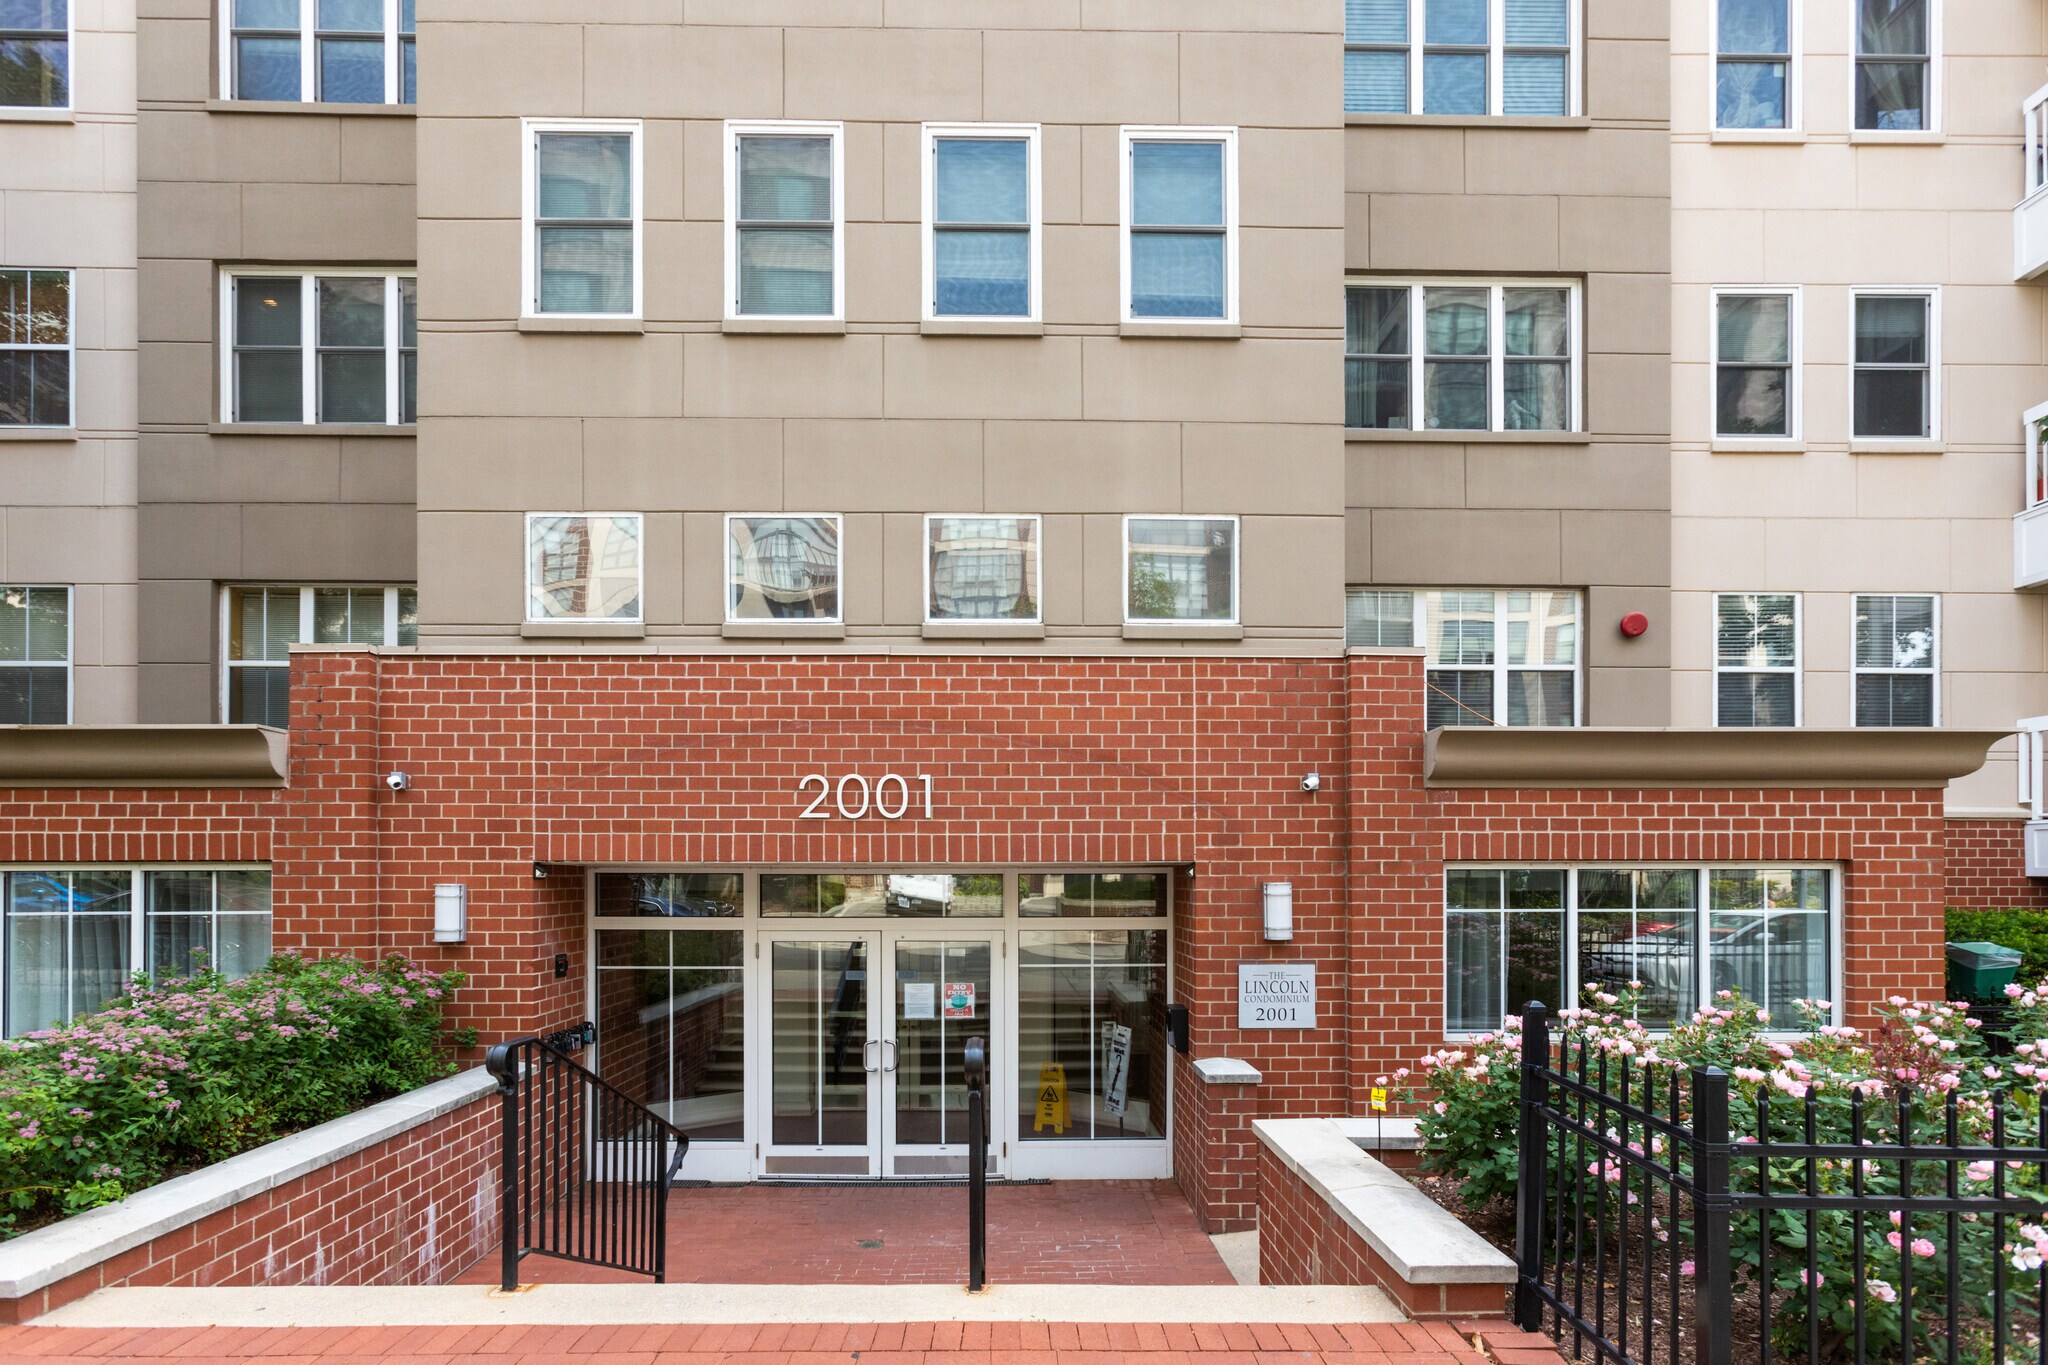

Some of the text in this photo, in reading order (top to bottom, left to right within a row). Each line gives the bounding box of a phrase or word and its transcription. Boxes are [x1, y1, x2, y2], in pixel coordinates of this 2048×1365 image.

[798, 773, 932, 819] 2001
[1245, 981, 1309, 993] LINCOLN
[1244, 995, 1310, 1003] CONDOMINIUM
[1256, 1008, 1296, 1021] 2001
